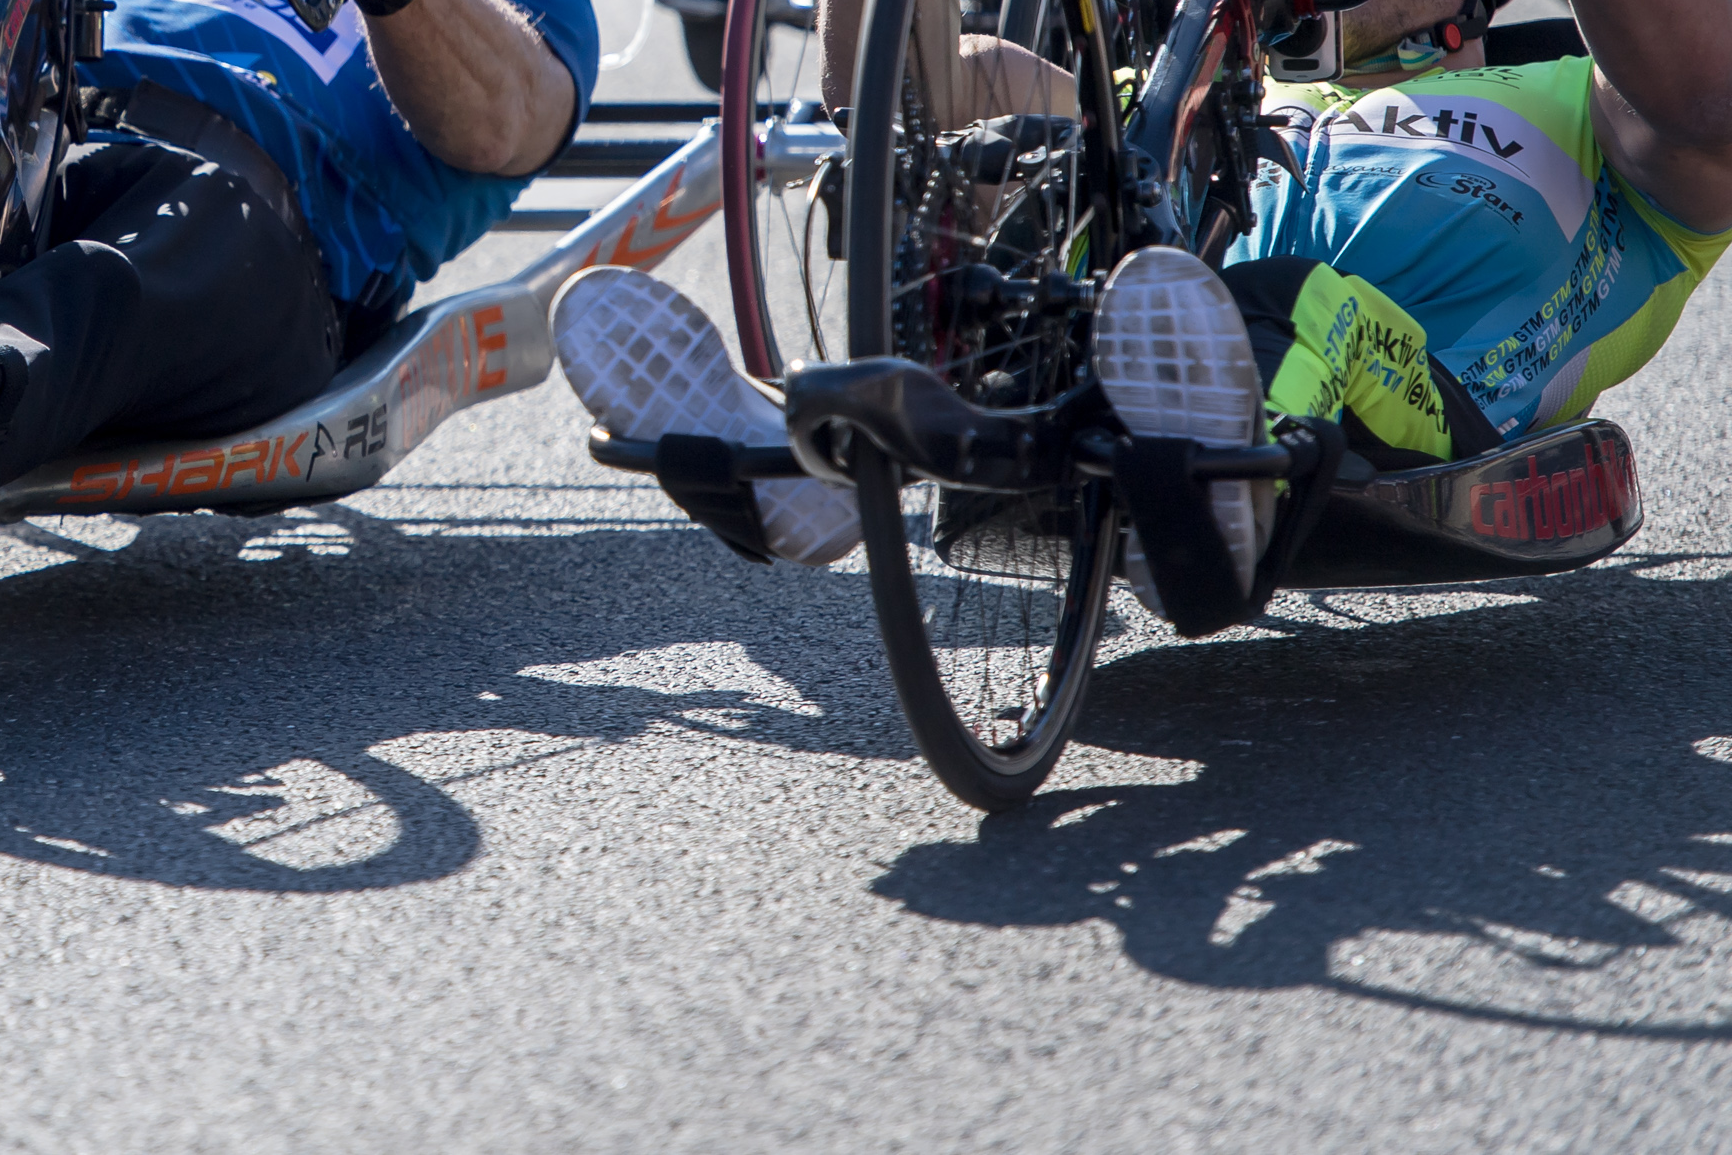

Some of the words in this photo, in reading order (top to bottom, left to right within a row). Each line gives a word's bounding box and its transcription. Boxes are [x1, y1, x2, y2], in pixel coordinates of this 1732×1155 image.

[1450, 178, 1525, 226] Start
[57, 431, 310, 504] SHARK
[344, 403, 387, 459] RS
